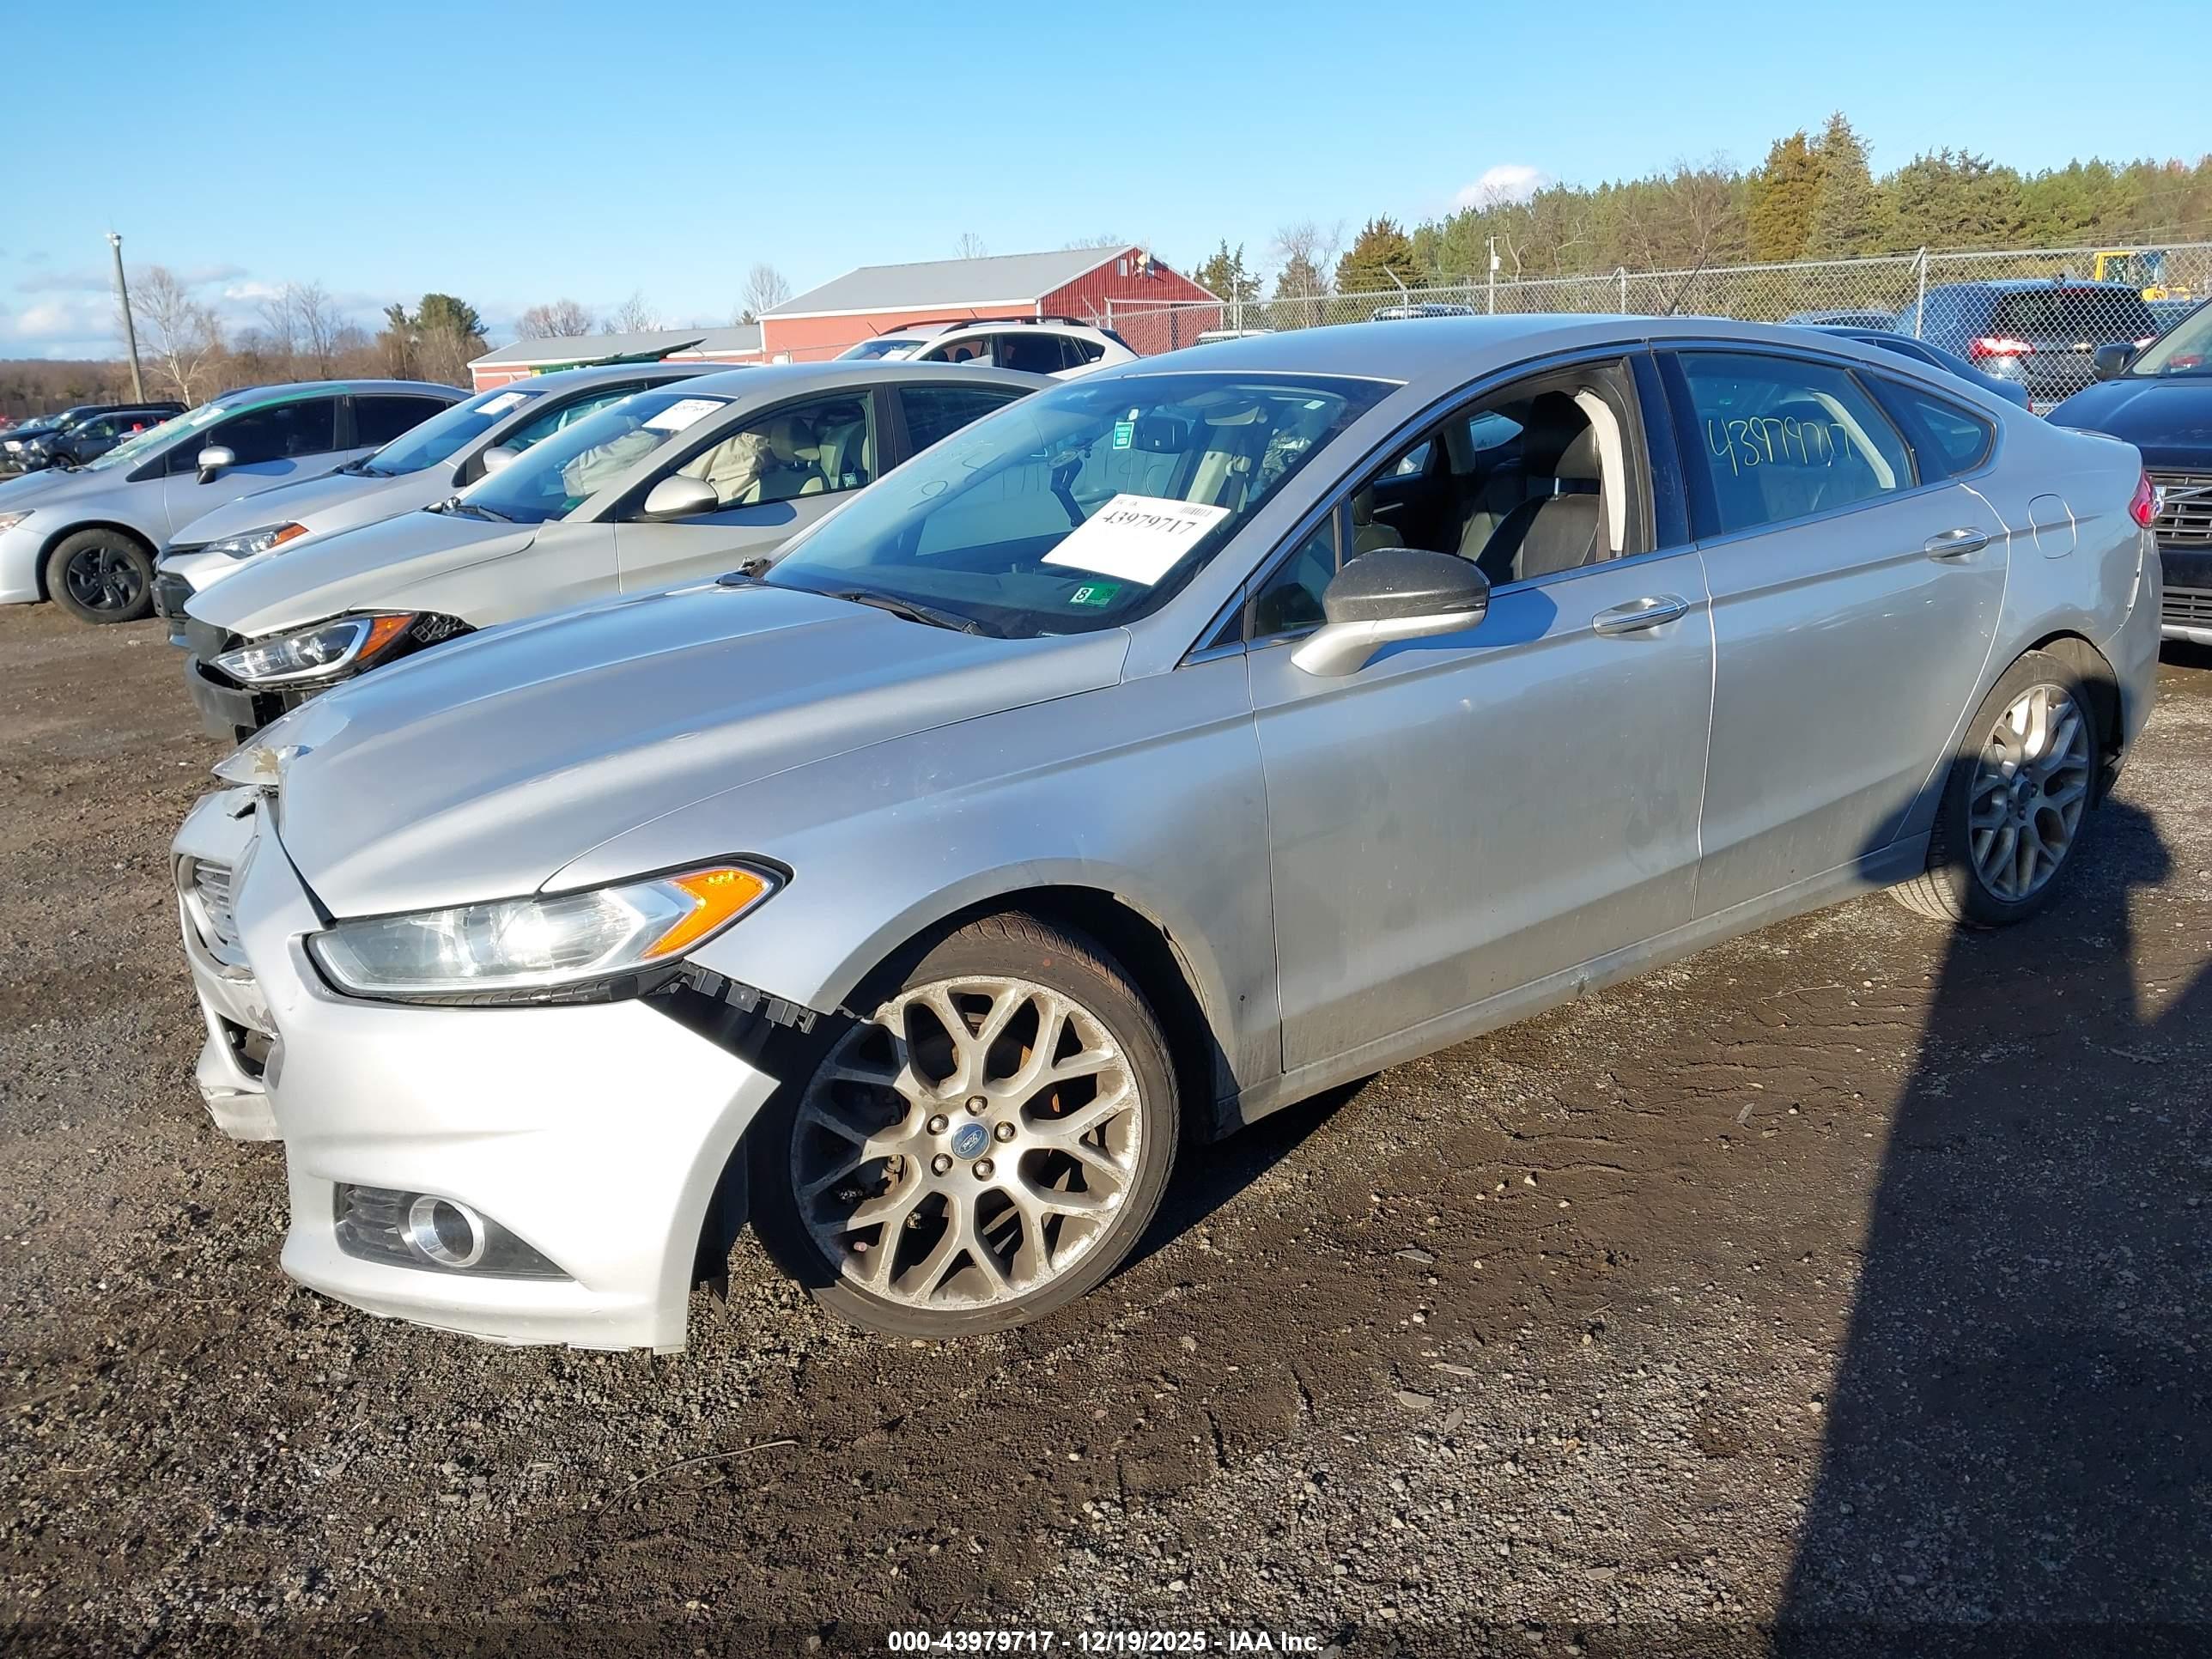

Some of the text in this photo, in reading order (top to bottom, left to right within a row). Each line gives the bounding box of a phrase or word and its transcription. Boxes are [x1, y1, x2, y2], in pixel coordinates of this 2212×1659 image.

[1708, 416, 1851, 477] 43979717
[1103, 511, 1198, 534] 43979717
[1076, 588, 1090, 600] 8
[962, 1132, 979, 1151] Ford
